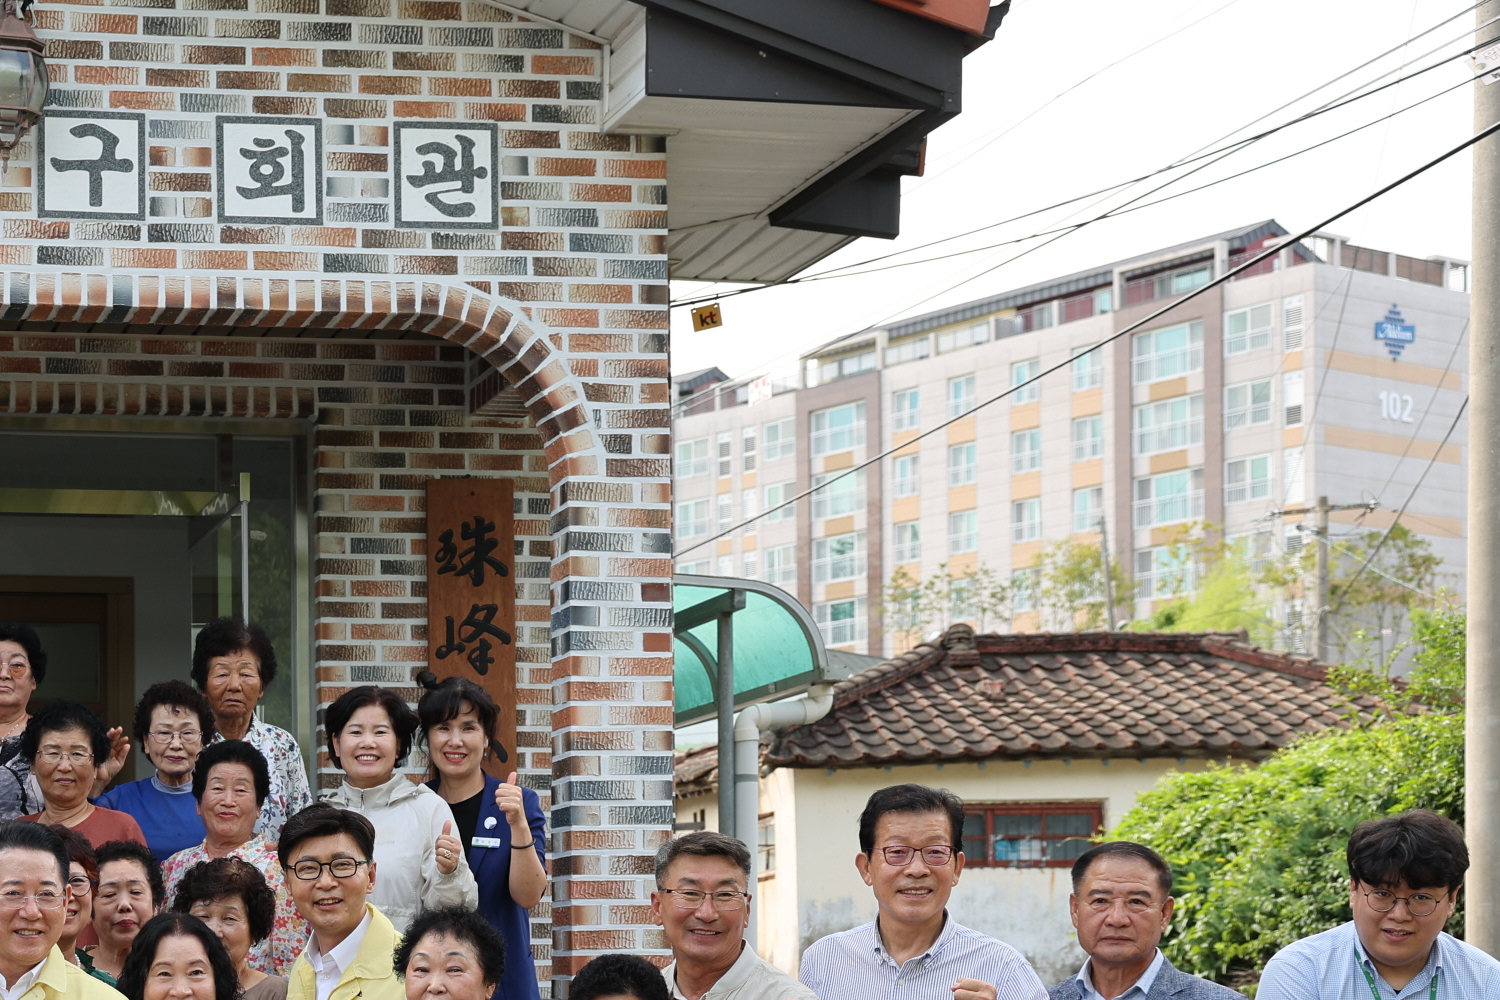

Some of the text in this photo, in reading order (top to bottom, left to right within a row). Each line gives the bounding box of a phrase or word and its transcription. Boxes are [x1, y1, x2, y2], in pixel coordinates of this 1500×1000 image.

[699, 311, 718, 327] kt
[1378, 390, 1414, 424] 102
[435, 515, 512, 764] 珠峰
